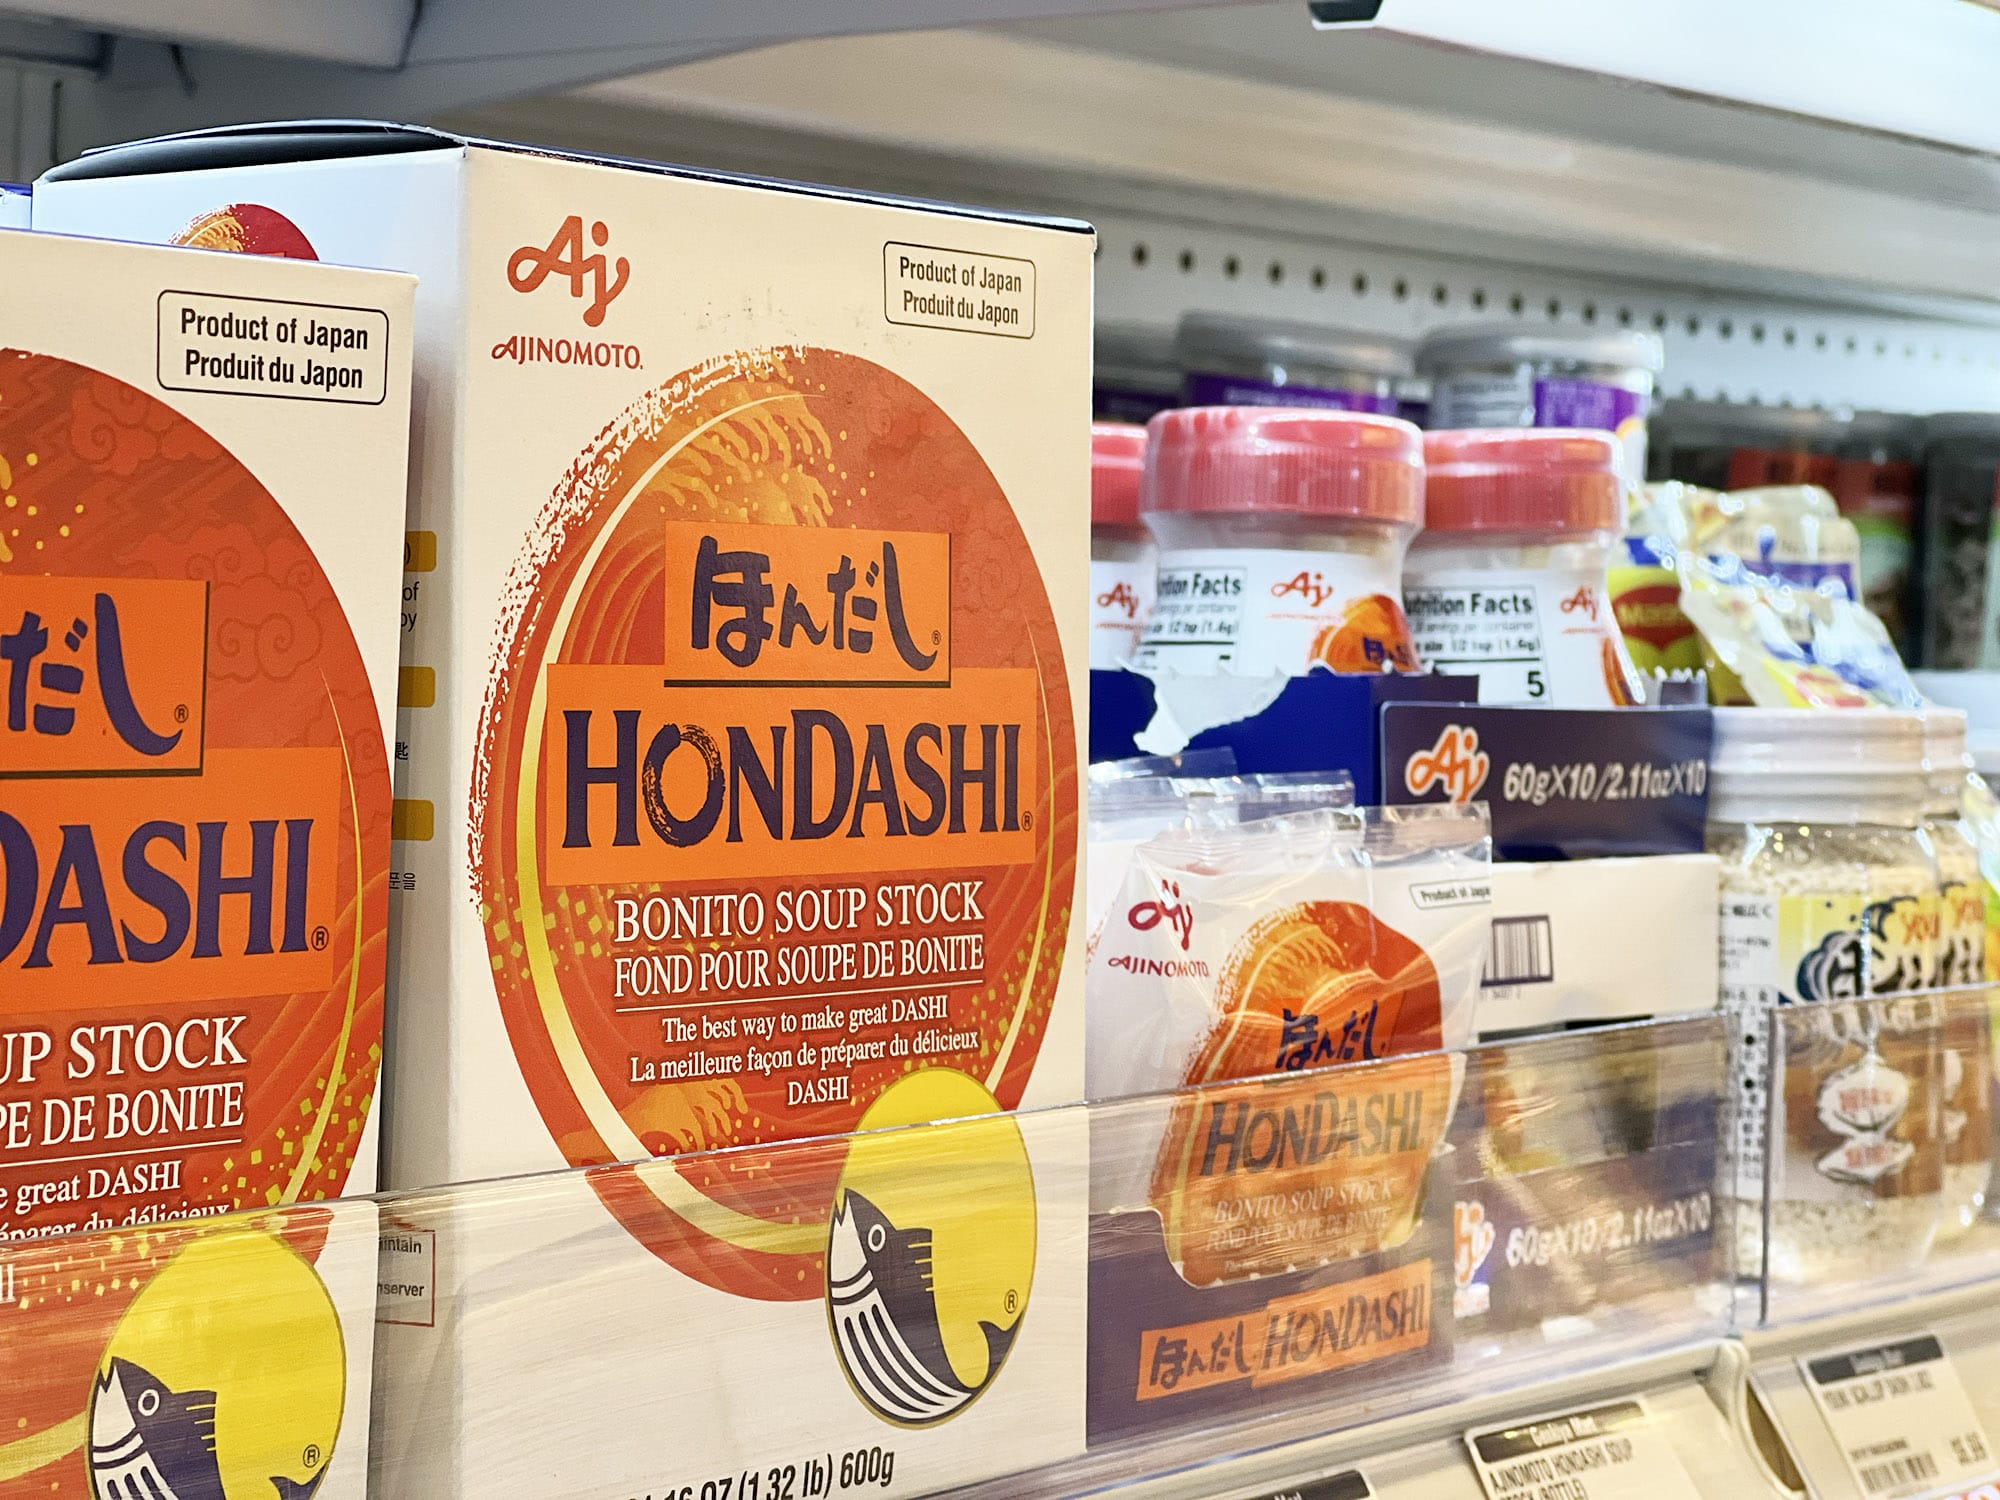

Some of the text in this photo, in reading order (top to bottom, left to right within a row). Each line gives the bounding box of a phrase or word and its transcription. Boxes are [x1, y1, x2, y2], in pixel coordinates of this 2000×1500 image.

[900, 256, 1021, 295] Product of Japan
[181, 308, 368, 352] Product of Japan
[904, 290, 1018, 327] Produit du Japon
[185, 349, 363, 392] Produit du Japon
[691, 536, 936, 671] ほんだし
[1191, 573, 1241, 596] Facts
[1471, 593, 1533, 615] Facts
[1528, 671, 1545, 697] 5
[562, 709, 1021, 848] HONDASHI
[614, 881, 984, 942] BONITO SOUP STOCK
[614, 934, 984, 997] FOND POUR SOUPE DE BONITE
[662, 995, 948, 1042] The best way to make great DASHI
[67, 1015, 248, 1080] STOCK
[631, 1028, 979, 1082] La meilleure façon de préparer du délicieux
[41, 1095, 95, 1146] DE
[104, 1081, 245, 1140] BONITE
[788, 1076, 849, 1105] DASHI
[1200, 1090, 1423, 1176] HONDASHI
[15, 1175, 80, 1215] great
[87, 1160, 182, 1199] DASHI
[1214, 1194, 1287, 1223] BONITO
[1290, 1186, 1334, 1215] SOUP
[1150, 1283, 1425, 1390] ほんだし HONDASHI
[739, 1465, 796, 1500] (132
[802, 1453, 833, 1499] lb)
[840, 1447, 895, 1488] 600g
[1489, 1458, 1553, 1493] AJINOMOTO
